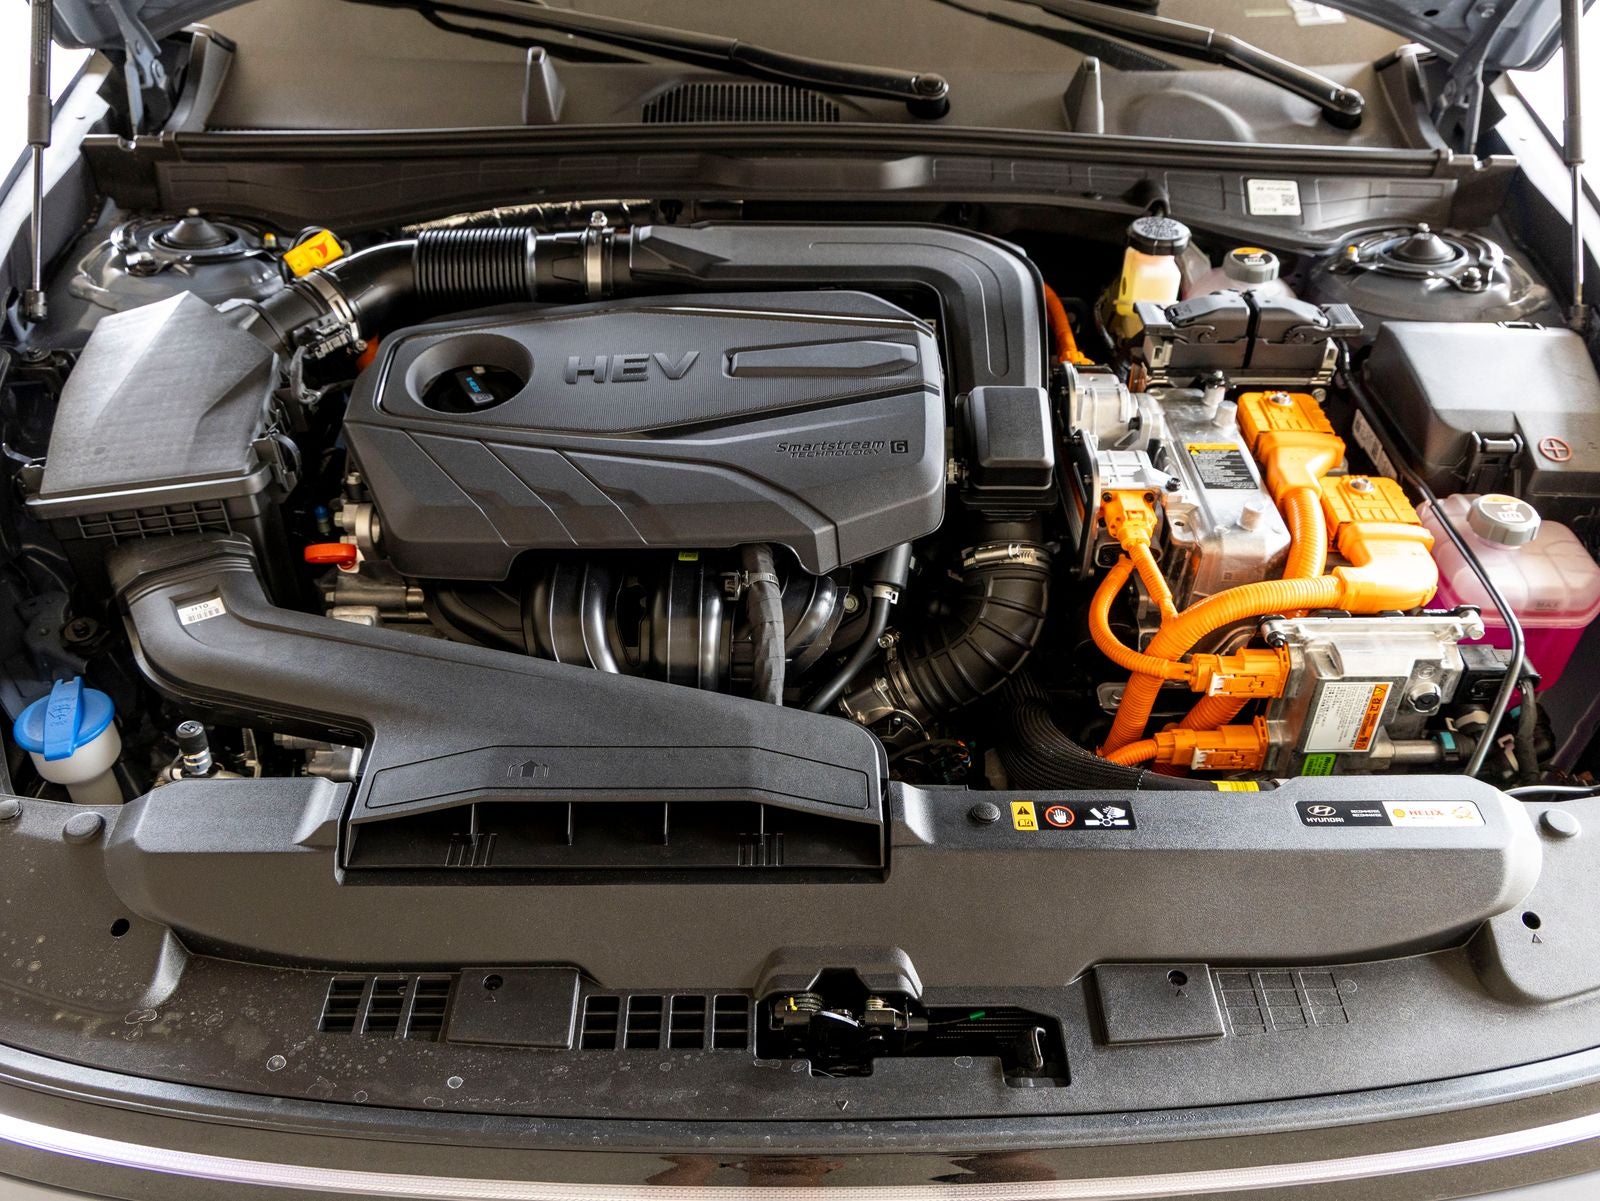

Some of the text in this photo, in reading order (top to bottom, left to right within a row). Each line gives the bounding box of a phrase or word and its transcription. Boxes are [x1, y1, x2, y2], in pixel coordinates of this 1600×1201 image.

[565, 351, 700, 384] HEV
[776, 440, 907, 453] Smartstream G
[790, 449, 880, 458] TECHNOLOGY
